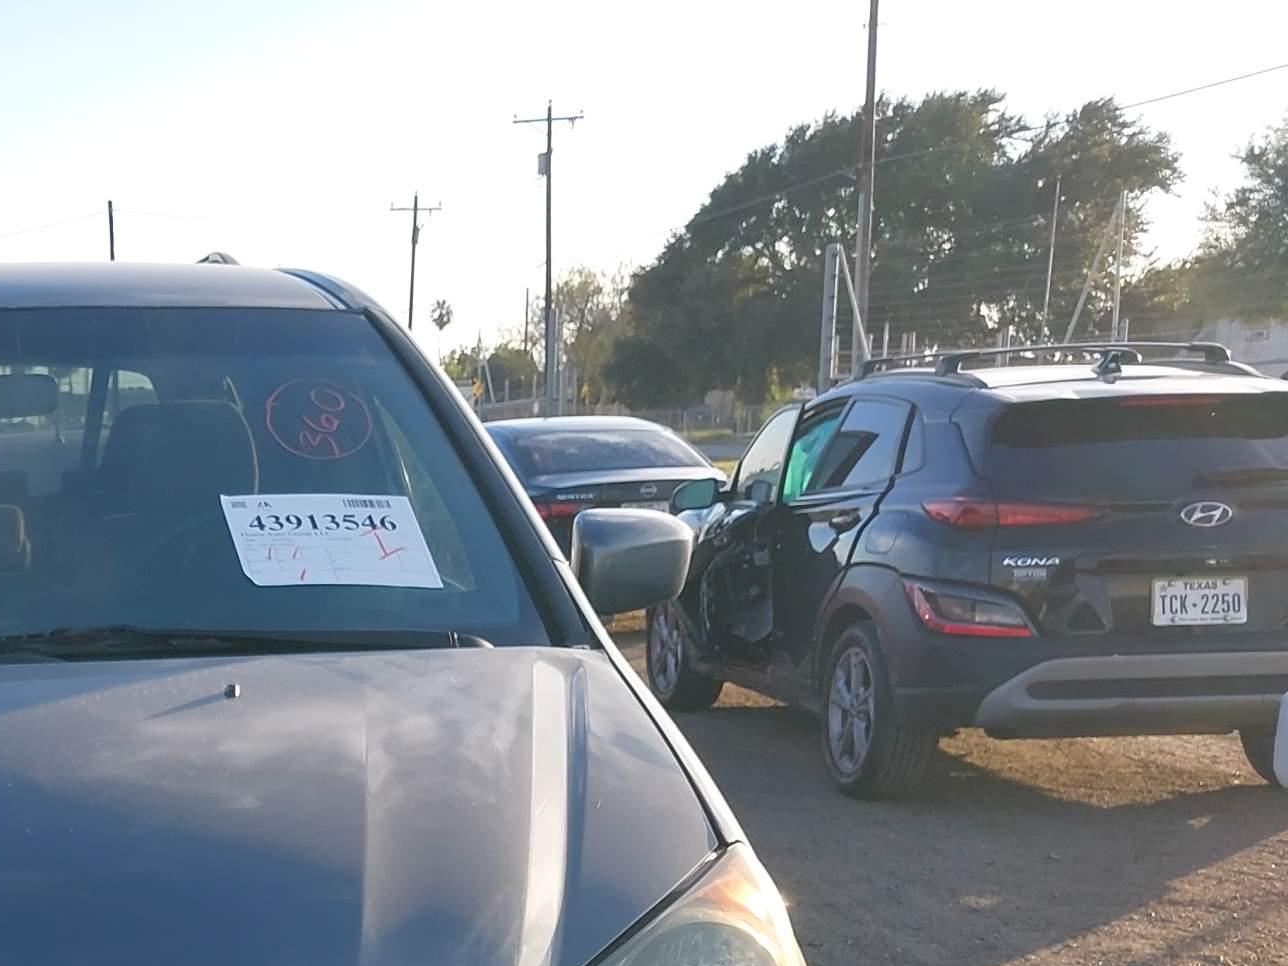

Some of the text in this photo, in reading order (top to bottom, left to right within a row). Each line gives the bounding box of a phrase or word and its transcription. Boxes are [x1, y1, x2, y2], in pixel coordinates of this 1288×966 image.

[248, 513, 398, 532] 43913546
[1003, 556, 1060, 567] KONA
[1183, 581, 1218, 591] TEXAS
